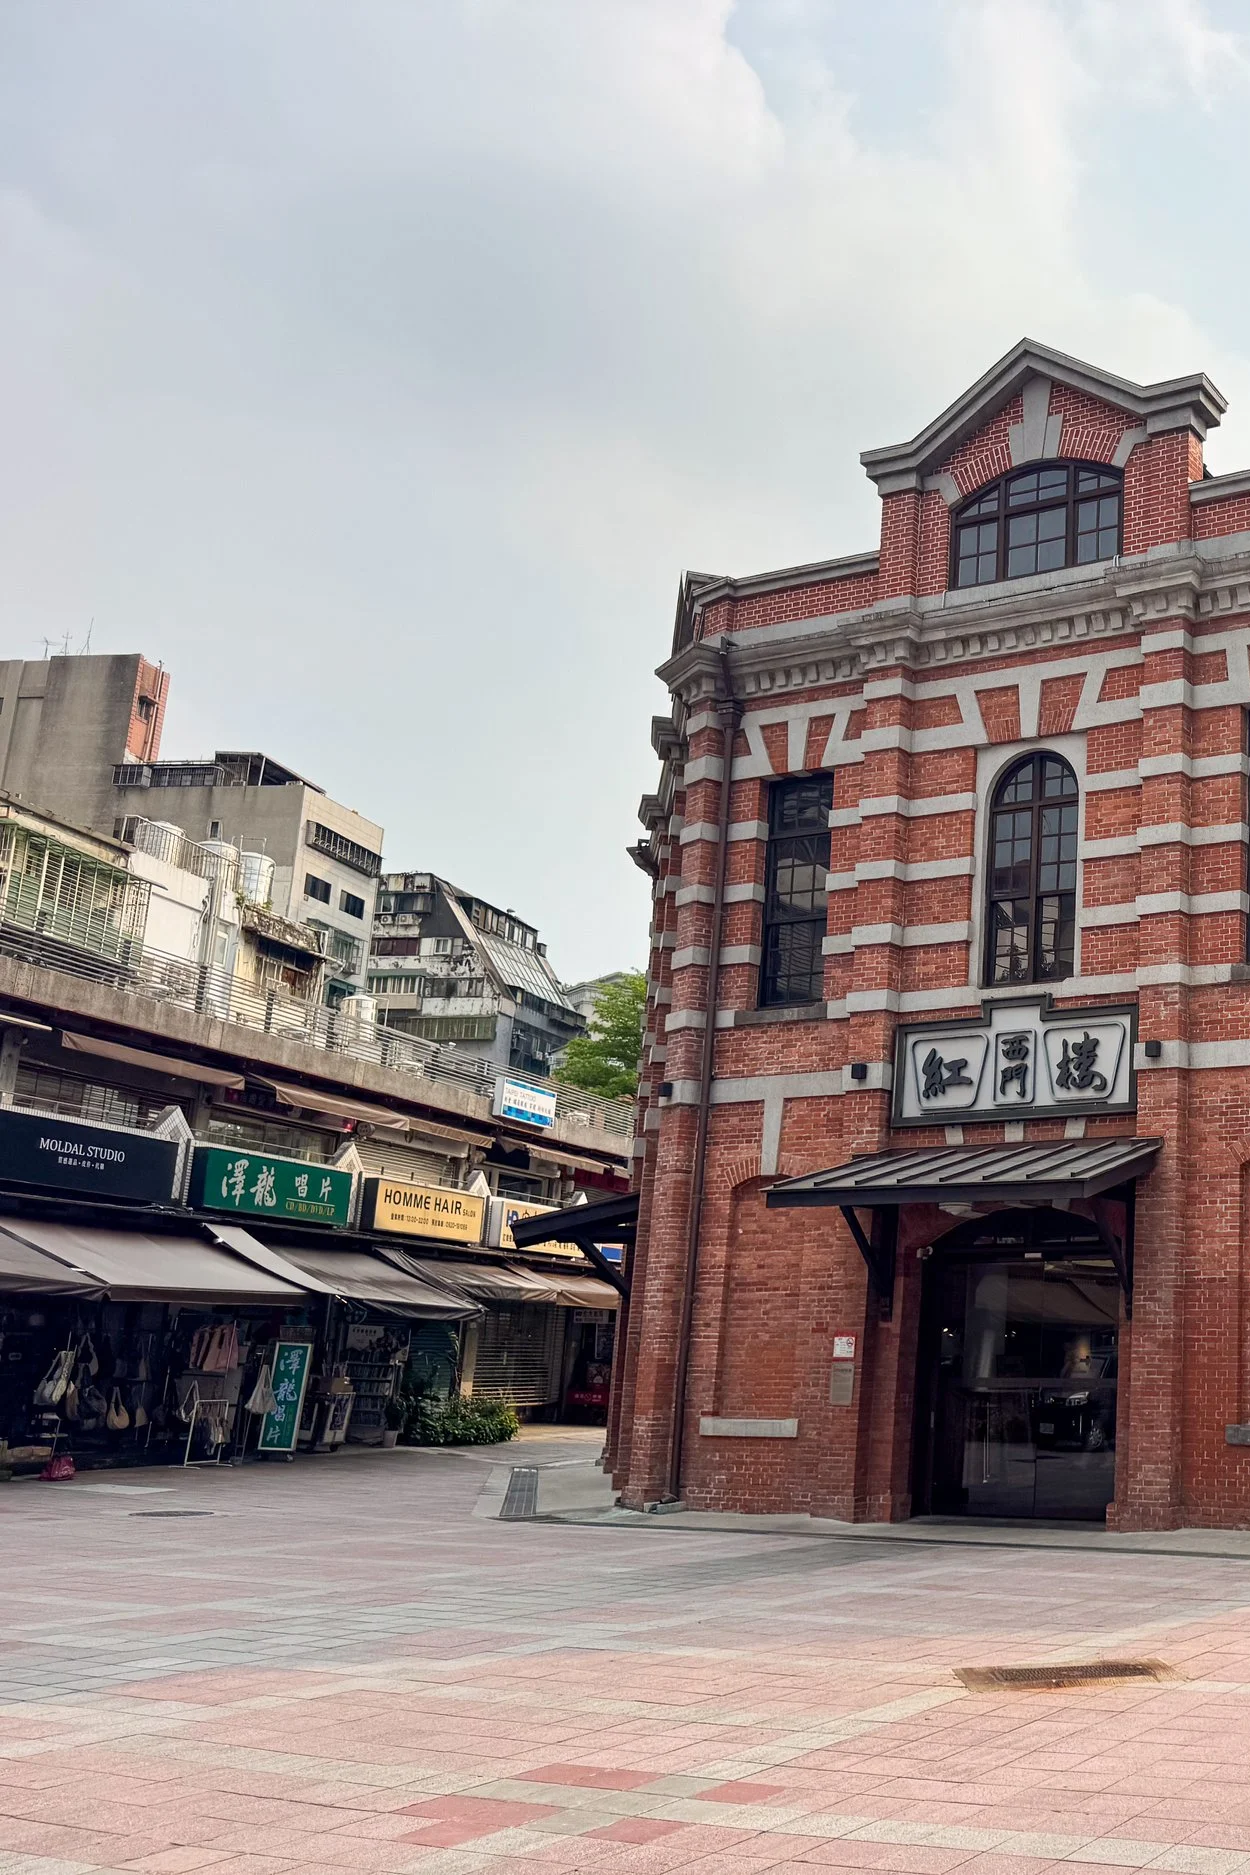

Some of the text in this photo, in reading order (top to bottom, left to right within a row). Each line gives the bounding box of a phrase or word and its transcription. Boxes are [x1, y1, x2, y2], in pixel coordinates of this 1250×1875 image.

[922, 1048, 973, 1099] 紅
[1000, 1035, 1029, 1098] 西門
[39, 1137, 125, 1162] MOLDAL STUDIO
[221, 1158, 333, 1207] 澤龍 唱片
[384, 1188, 431, 1210] HOMME
[433, 1197, 462, 1215] HAIR
